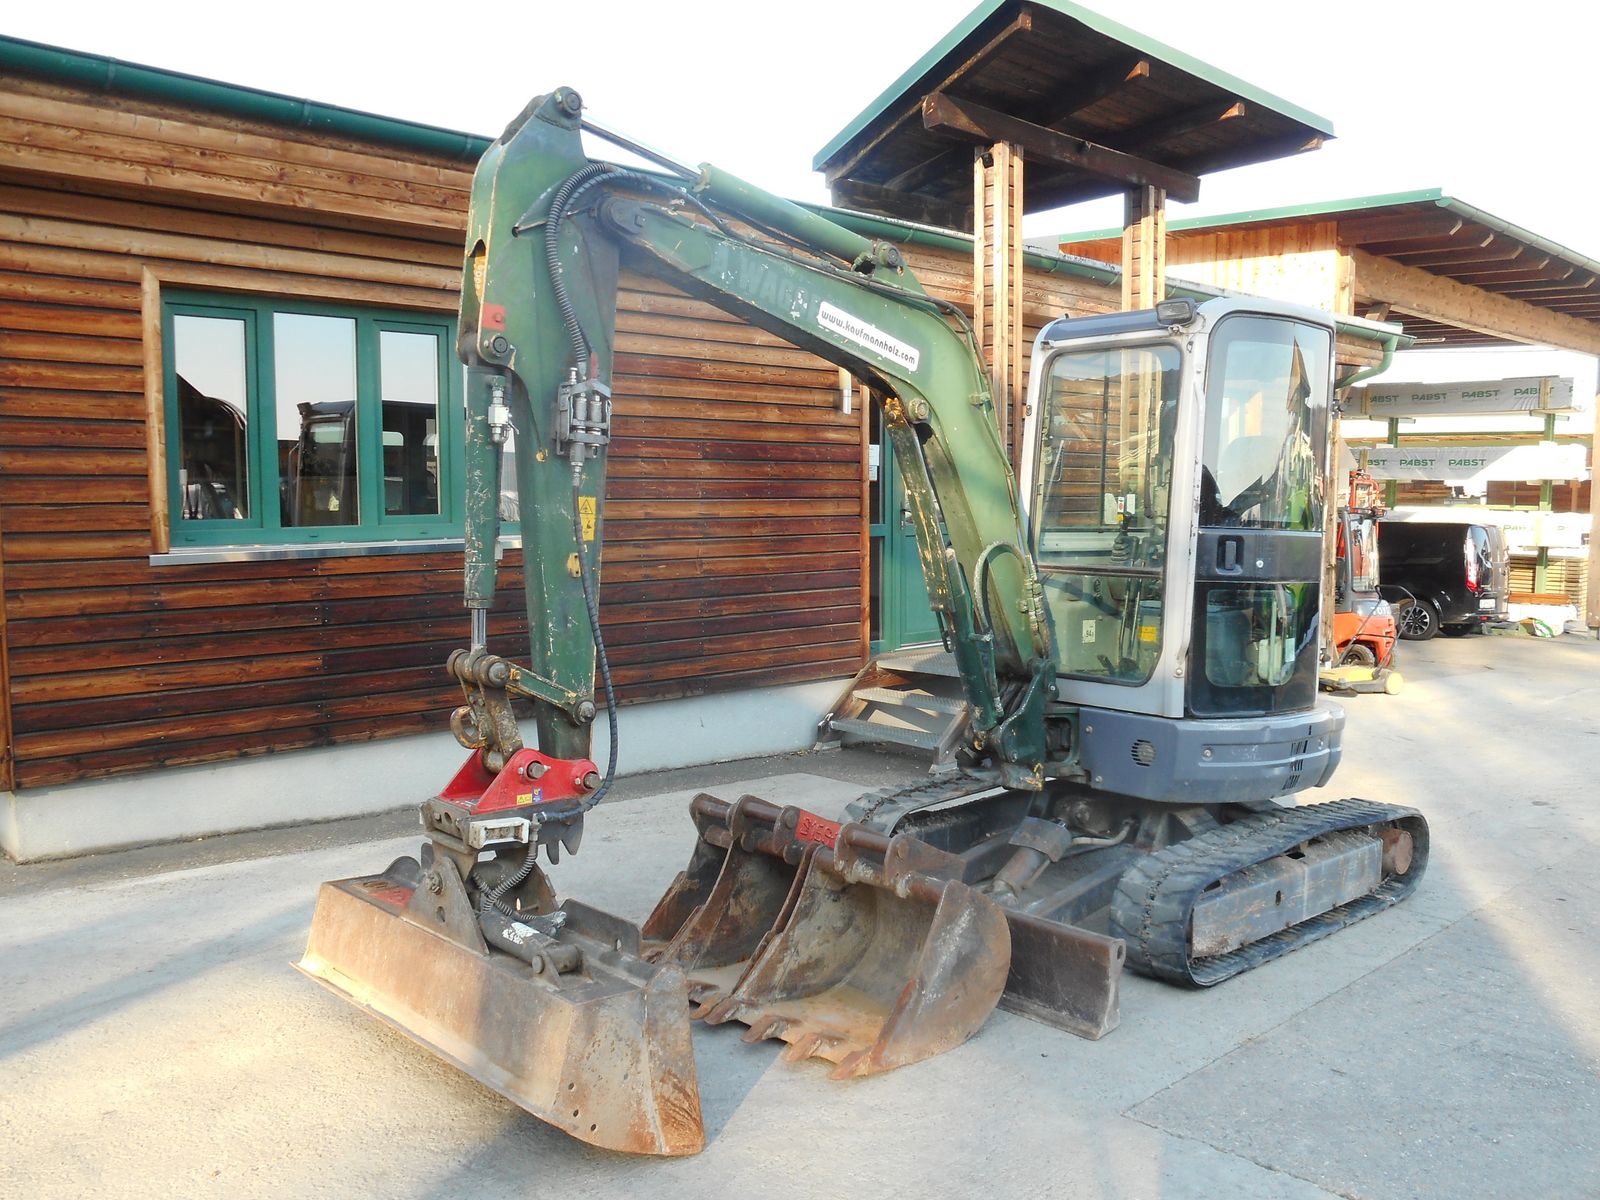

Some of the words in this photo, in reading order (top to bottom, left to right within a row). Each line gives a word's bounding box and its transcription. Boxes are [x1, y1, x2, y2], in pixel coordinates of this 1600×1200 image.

[821, 310, 915, 364] www.kaufmannholz.com
[1411, 393, 1447, 401] PABST
[1461, 389, 1499, 398] PABST
[1513, 386, 1554, 396] PABT
[1399, 458, 1435, 467] PABST
[1448, 458, 1486, 467] PABST
